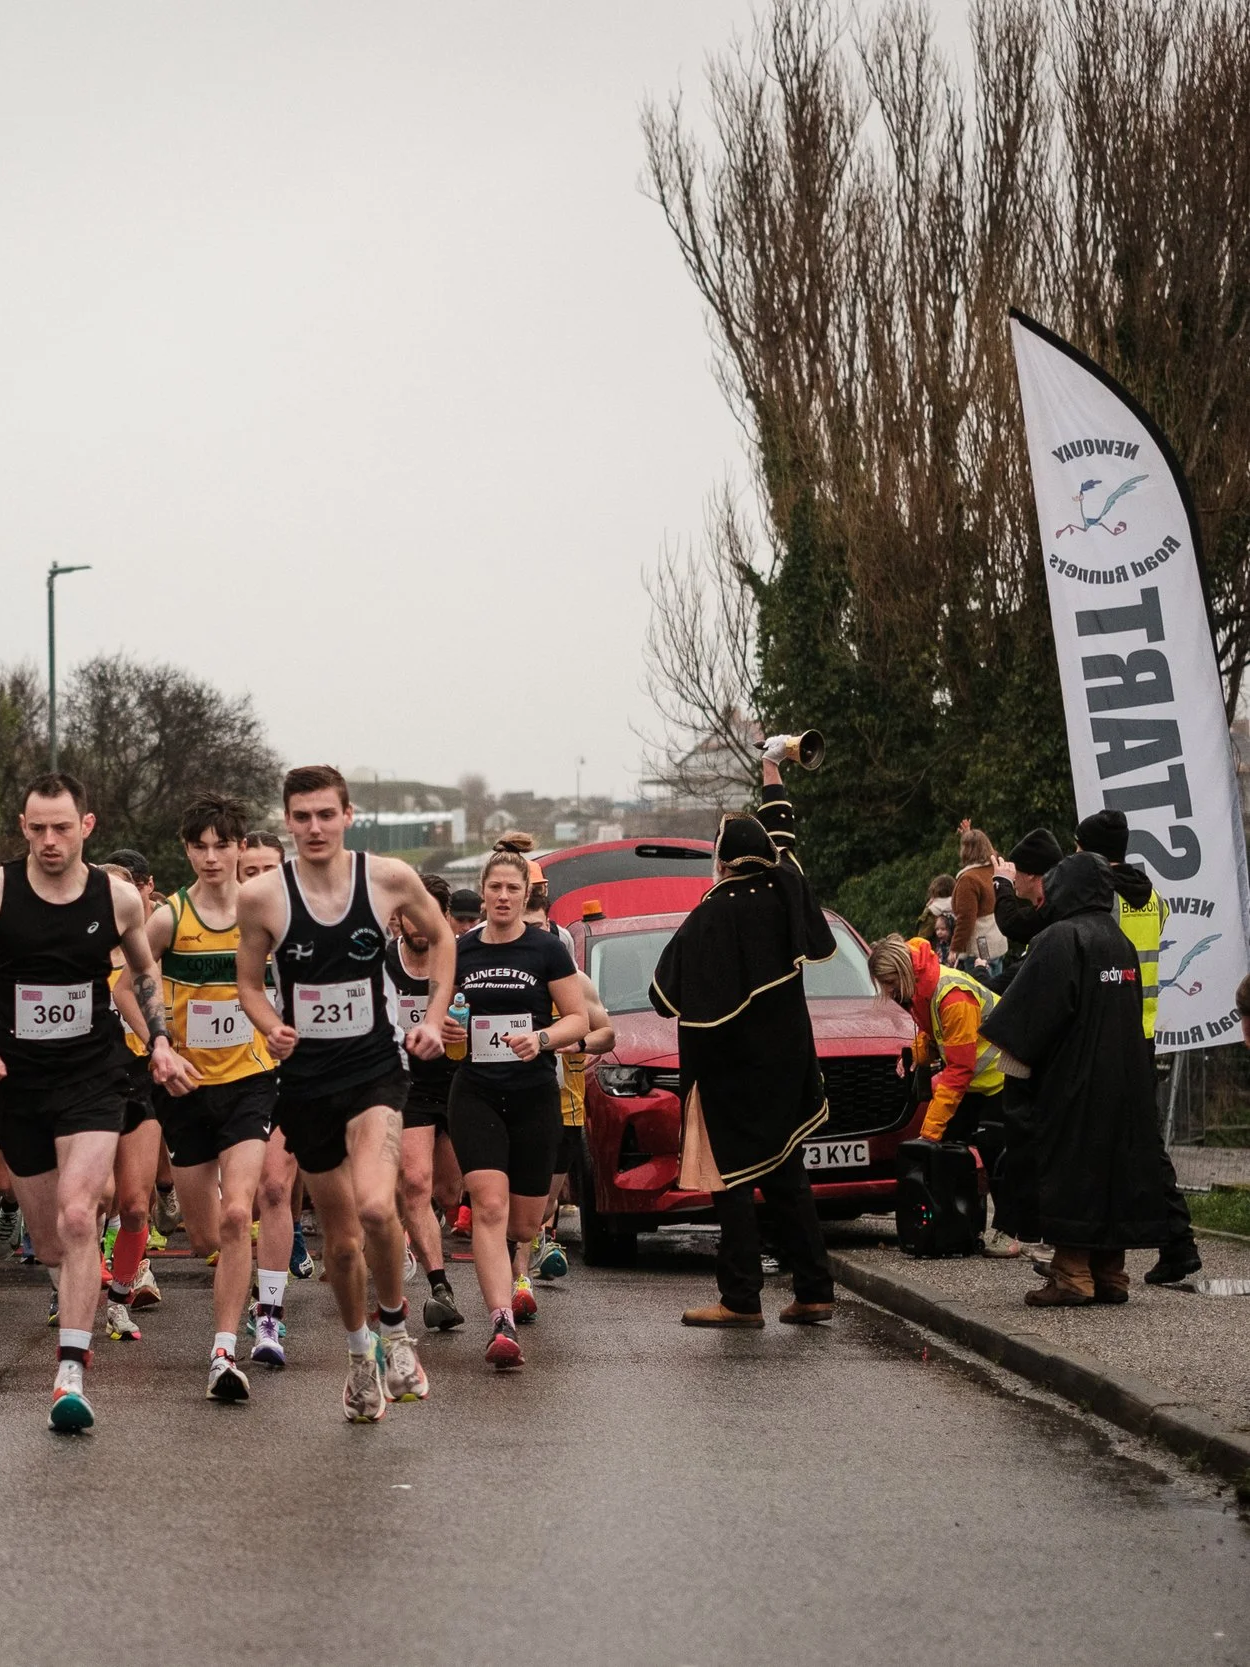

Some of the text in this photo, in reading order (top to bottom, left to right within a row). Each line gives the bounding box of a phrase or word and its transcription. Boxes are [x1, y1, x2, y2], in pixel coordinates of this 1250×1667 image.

[485, 982, 525, 990] Runners
[33, 1005, 75, 1024] 360
[312, 1002, 354, 1023] 231
[211, 1017, 235, 1035] 10
[827, 1144, 866, 1164] KYC
